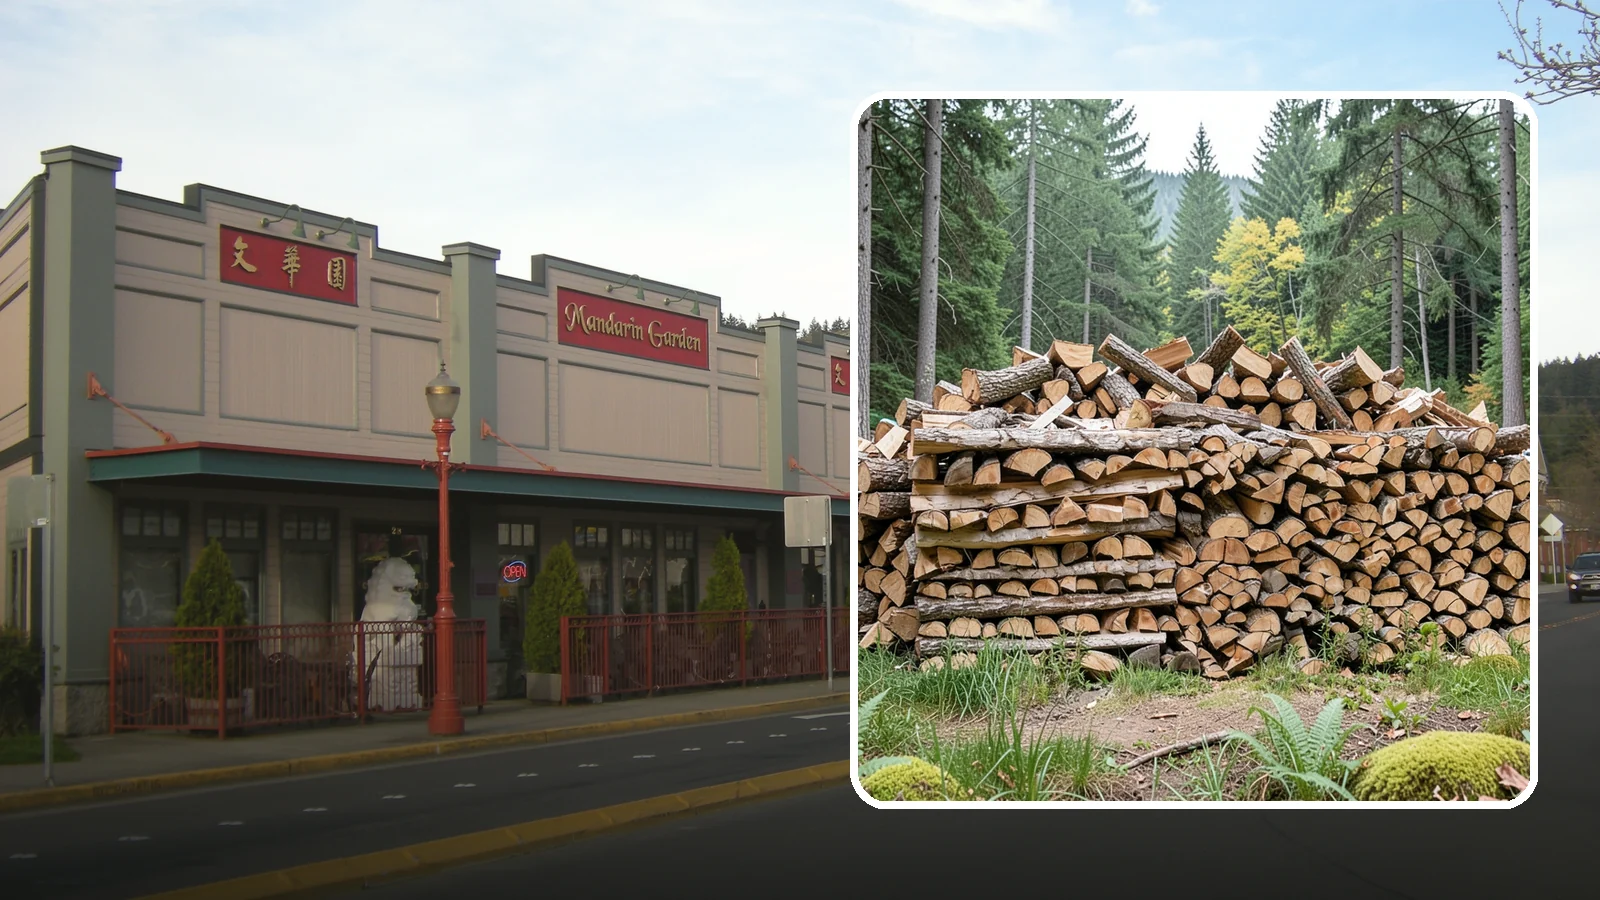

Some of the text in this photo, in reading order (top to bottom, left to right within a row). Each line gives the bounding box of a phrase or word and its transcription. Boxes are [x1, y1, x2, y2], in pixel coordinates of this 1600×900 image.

[230, 235, 346, 291] 文華園
[564, 302, 702, 352] Mandarin Garden
[503, 565, 527, 578] OPEN
